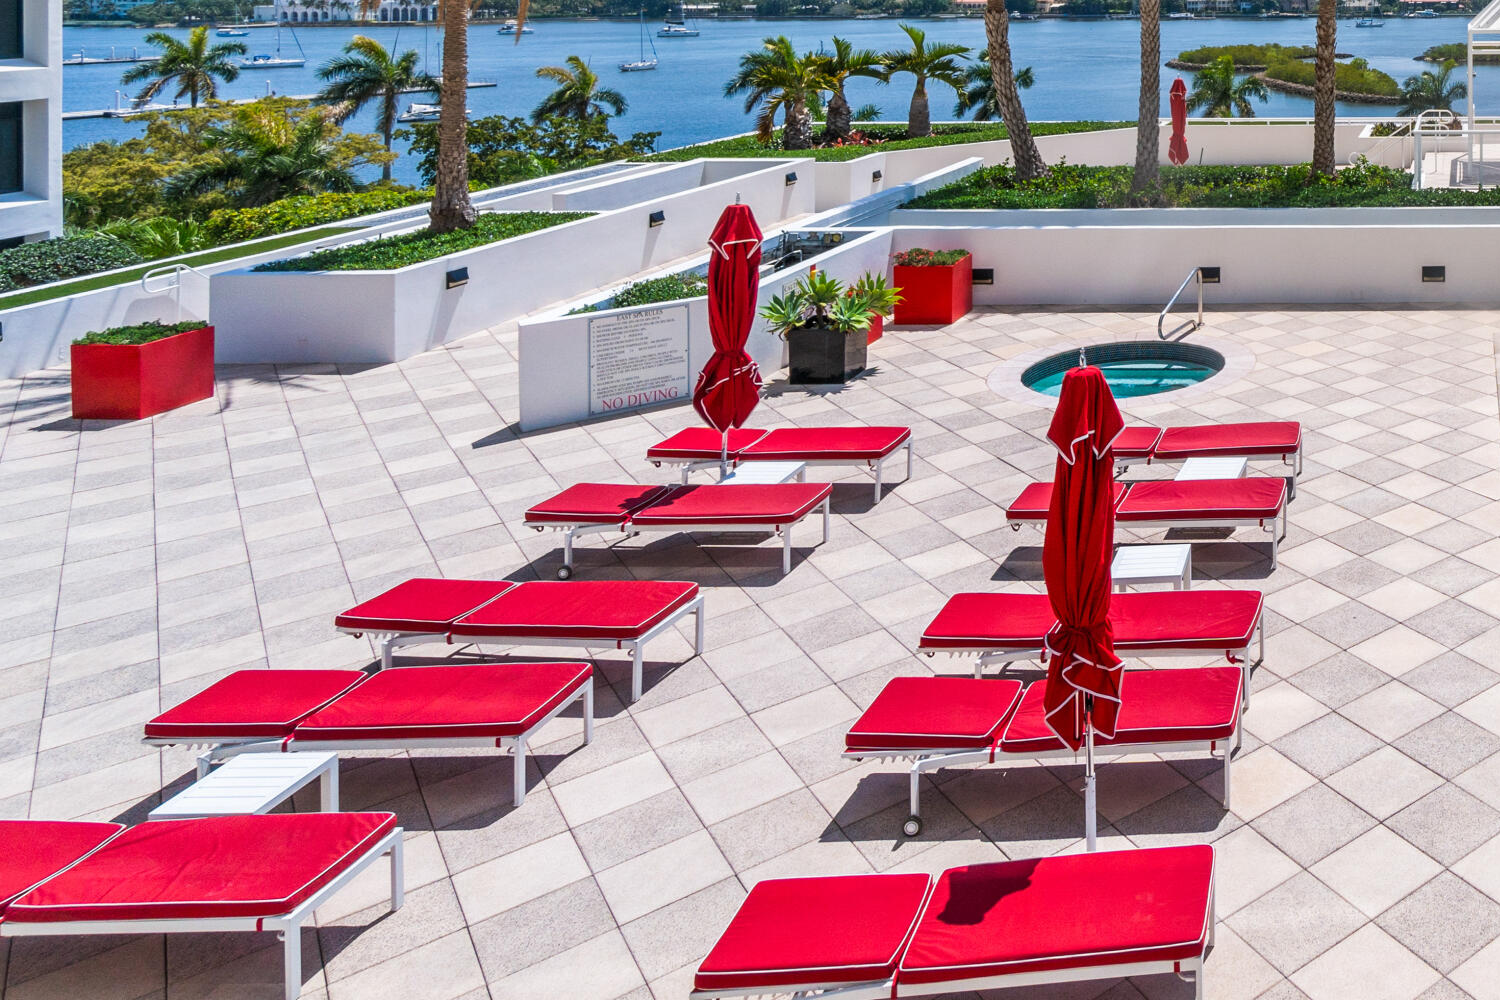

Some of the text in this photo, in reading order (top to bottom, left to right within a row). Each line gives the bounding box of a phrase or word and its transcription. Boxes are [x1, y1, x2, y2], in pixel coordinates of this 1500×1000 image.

[616, 309, 663, 321] EAST SPA RULES
[602, 387, 678, 411] NO DIVING
